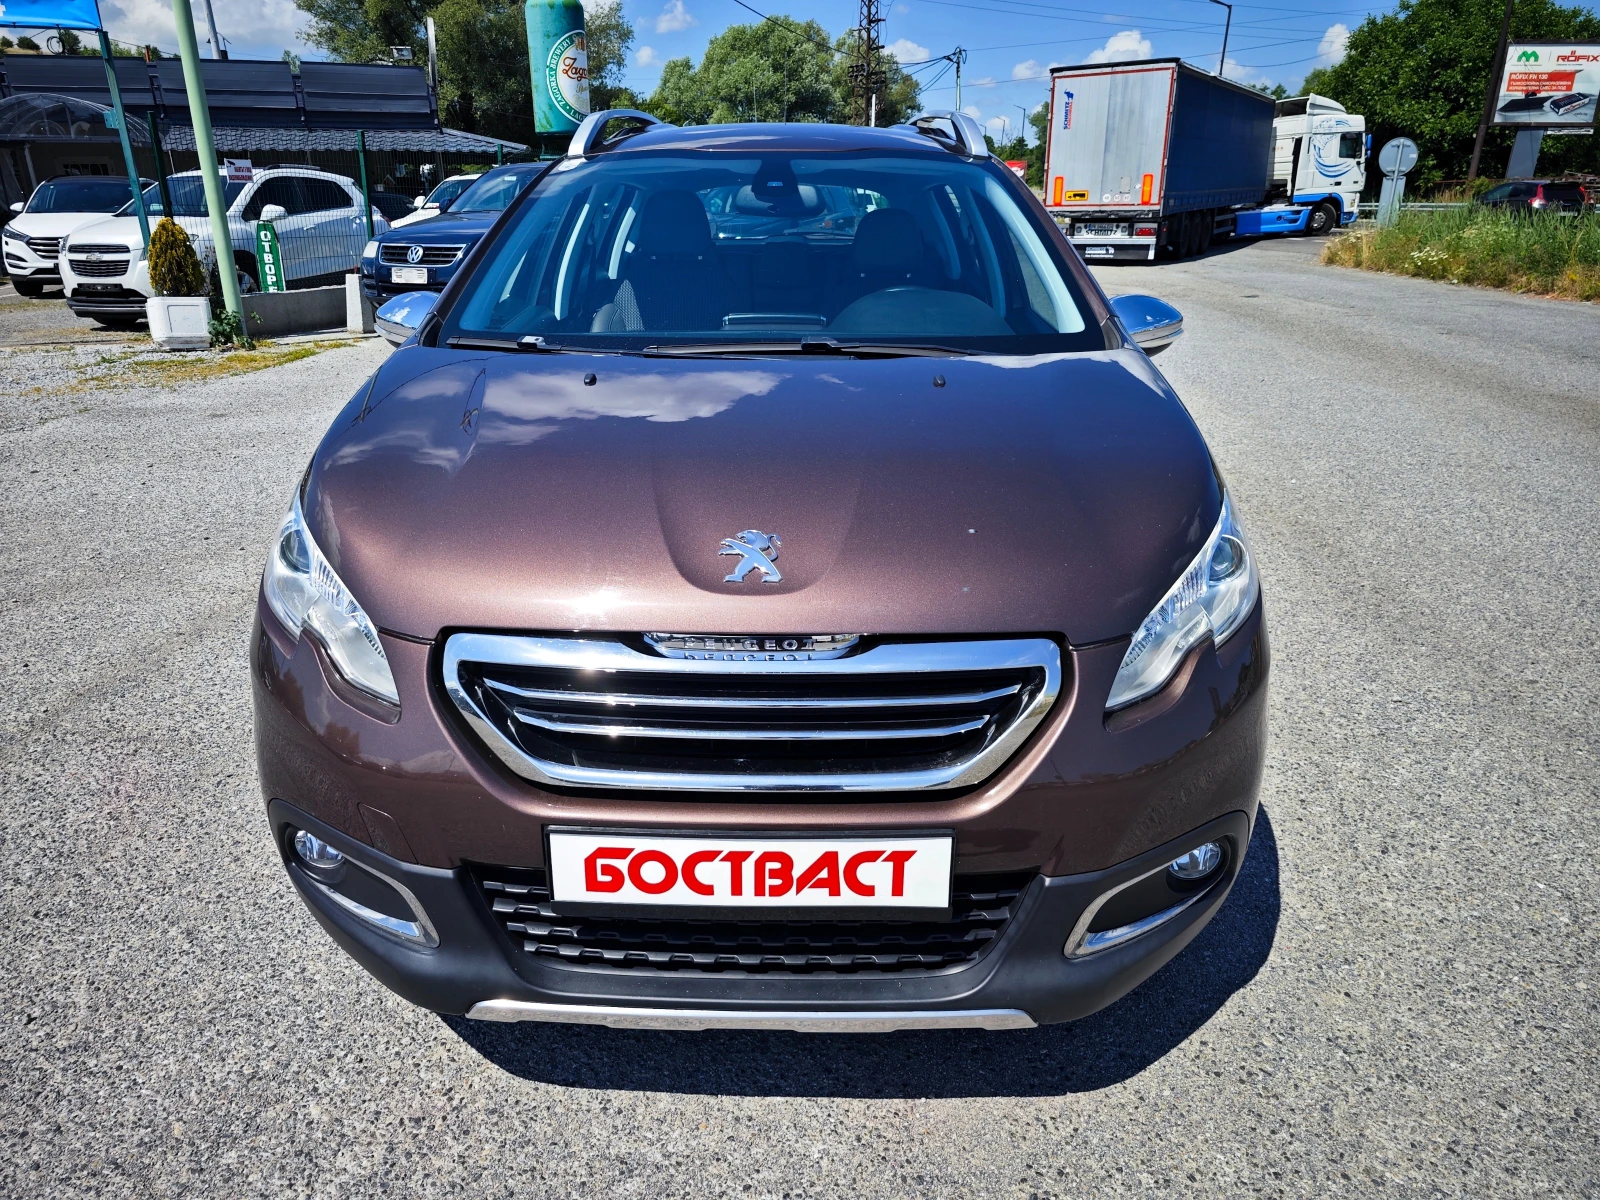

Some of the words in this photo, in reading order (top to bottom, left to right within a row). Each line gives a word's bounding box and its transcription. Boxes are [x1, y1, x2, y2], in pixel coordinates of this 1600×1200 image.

[549, 38, 571, 69] BREWERY
[1556, 50, 1599, 62] RÖFIX
[549, 70, 566, 107] ZAGORKA
[684, 638, 818, 650] PEUGEOT
[584, 846, 918, 897] БОСТВАСТ
